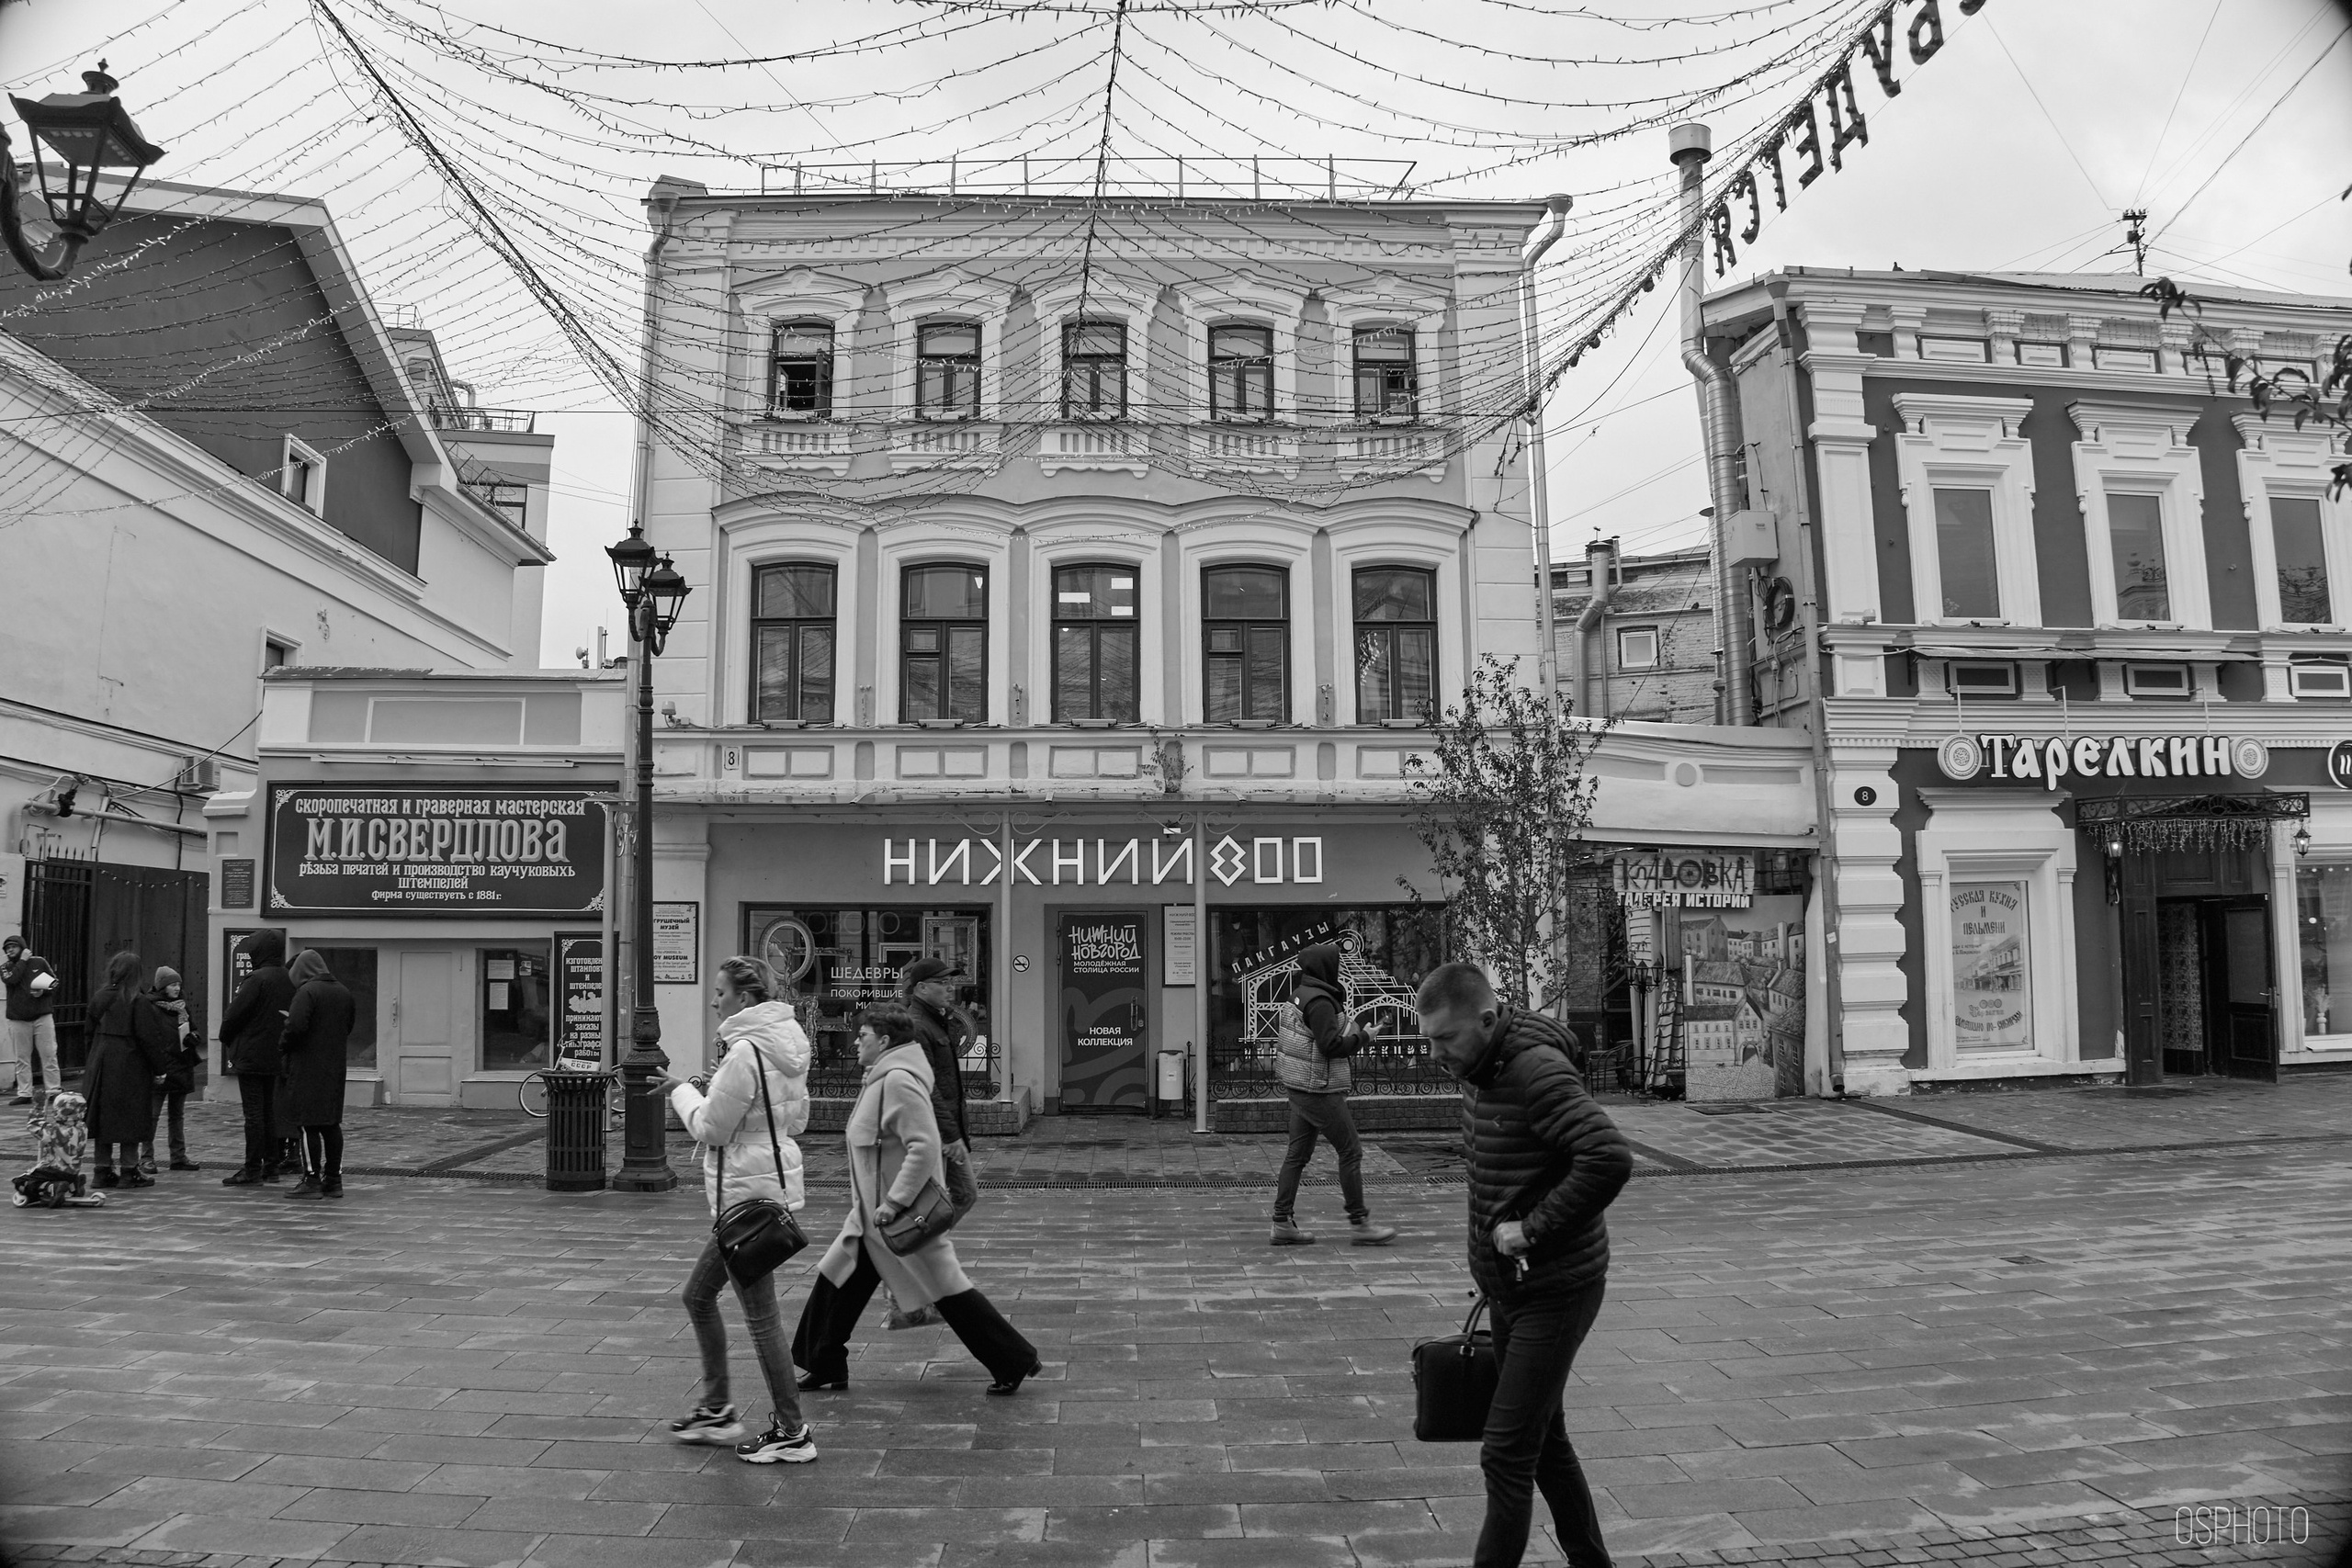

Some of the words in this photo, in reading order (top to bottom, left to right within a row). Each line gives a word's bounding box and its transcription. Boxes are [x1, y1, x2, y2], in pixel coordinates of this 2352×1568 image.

[728, 750, 735, 765] 8
[1978, 733, 2233, 792] Тарелкин
[1861, 791, 1869, 801] 8
[295, 798, 399, 818] скоропечатная
[402, 798, 411, 815] и
[415, 799, 492, 818] граверная
[495, 799, 586, 818] мастерская
[1209, 834, 1323, 887] 800
[343, 862, 389, 875] печатей
[392, 863, 401, 875] и
[404, 863, 485, 877] производство
[398, 876, 469, 889] штемпелей
[1068, 924, 1136, 944] НИЖНИЙ
[1231, 921, 1329, 974] ПАКГАУЗЫ
[566, 957, 603, 965] изготовлен
[831, 966, 903, 981] ШЕДЕВРЫ
[570, 982, 603, 990] штемпеле
[831, 988, 903, 998] ПОКОРИВШИЕ
[855, 1001, 872, 1010] МИ
[581, 1032, 601, 1042] разны
[1089, 1027, 1121, 1035] НОВАЯ
[1078, 1038, 1133, 1047] КОЛЛЕКЦИЯ
